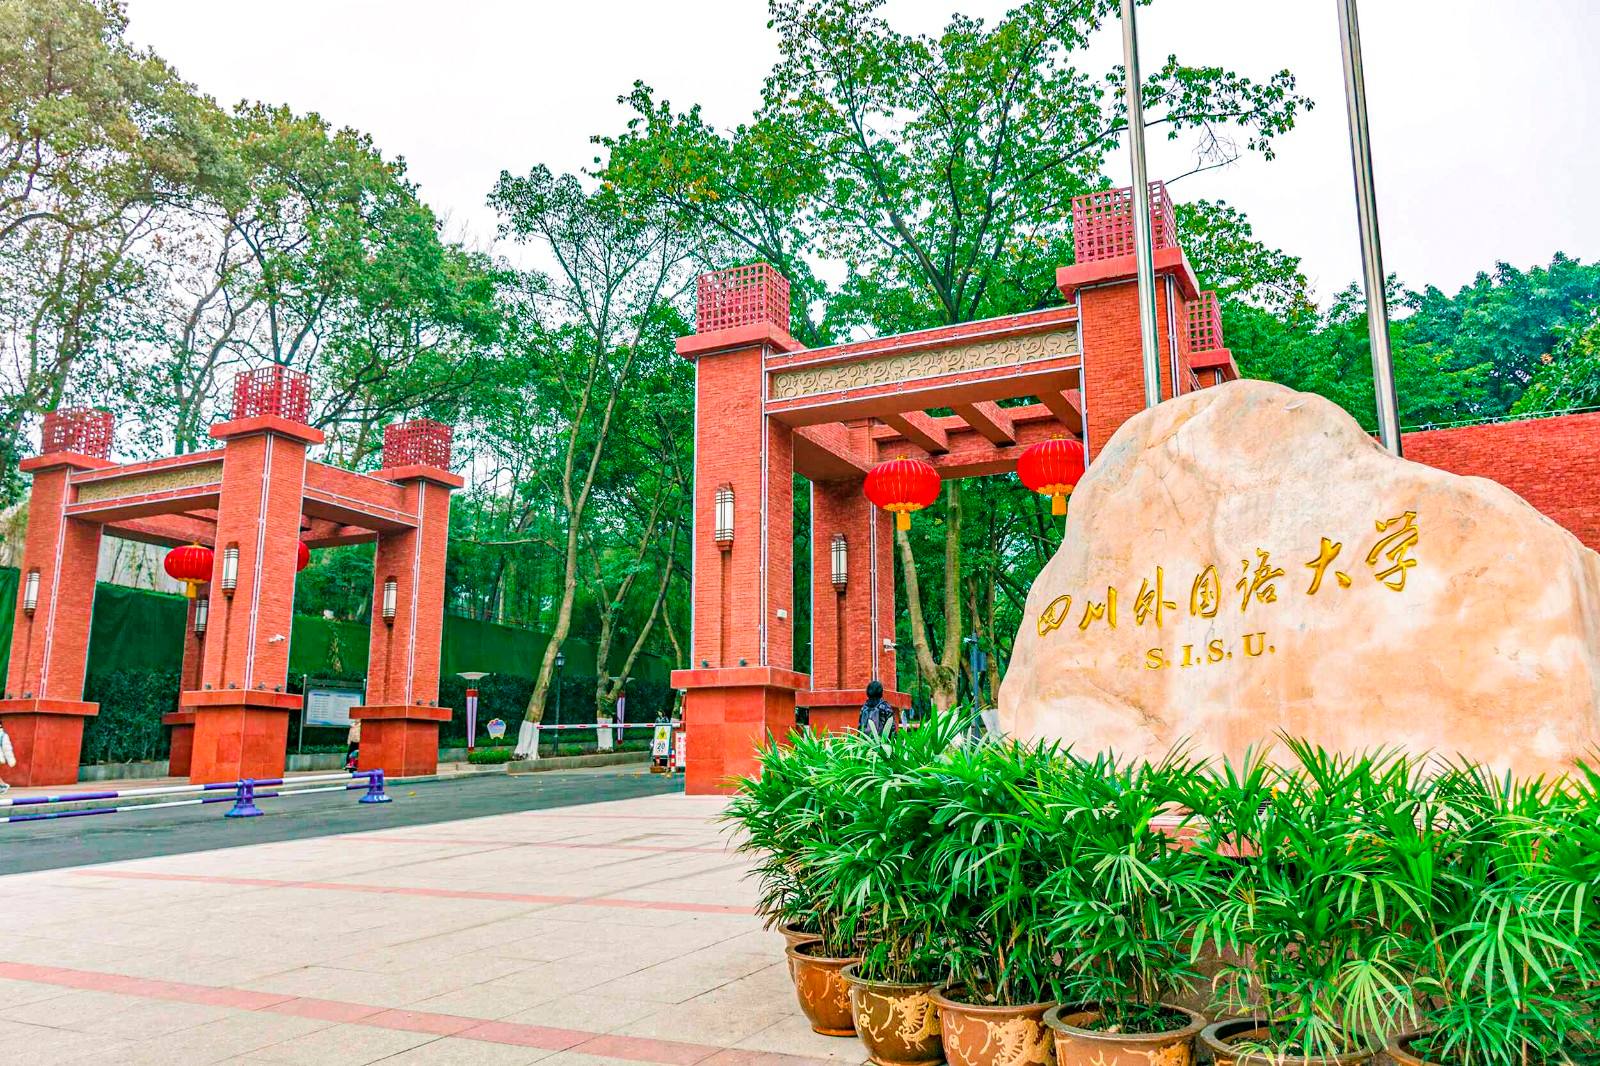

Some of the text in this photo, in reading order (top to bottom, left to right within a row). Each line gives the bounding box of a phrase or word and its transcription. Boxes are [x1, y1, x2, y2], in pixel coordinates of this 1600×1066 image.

[1038, 511, 1418, 637] 四川外国语大学
